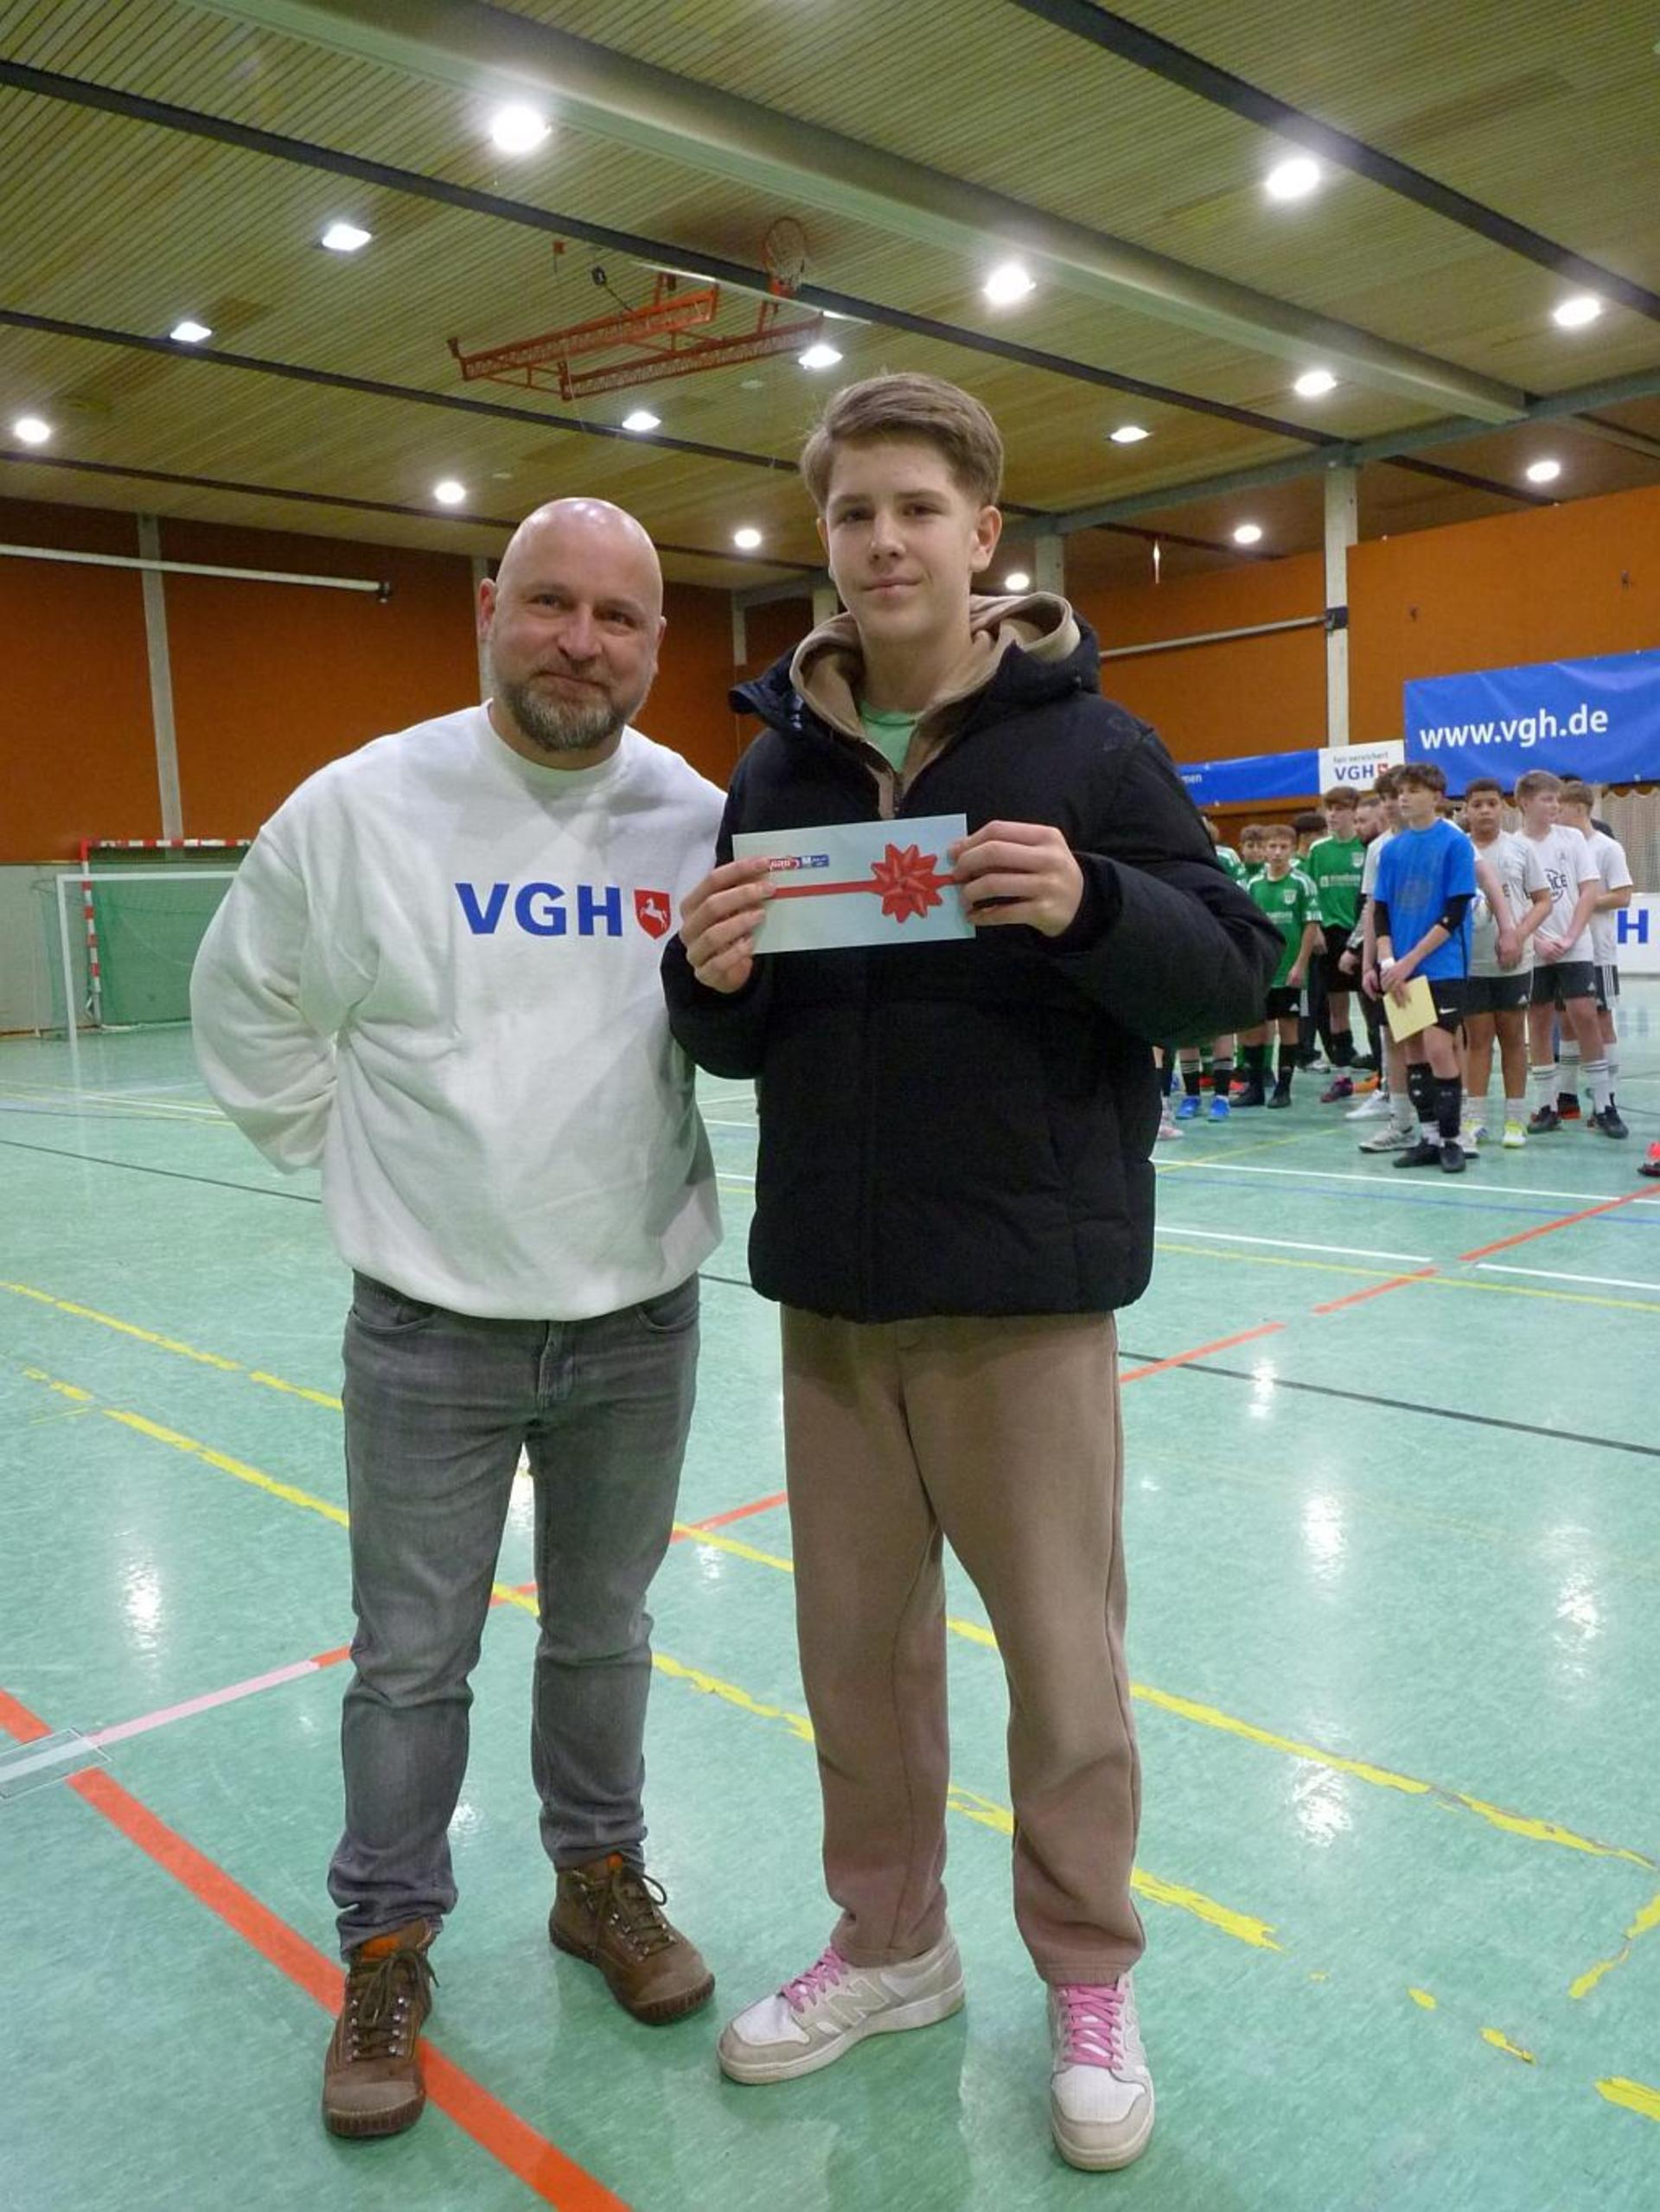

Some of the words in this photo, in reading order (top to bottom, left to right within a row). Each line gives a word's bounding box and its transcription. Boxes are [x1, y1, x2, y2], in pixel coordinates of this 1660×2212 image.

[1420, 704, 1609, 749] www.vgh.de
[1335, 764, 1374, 781] VGH
[455, 883, 623, 937] VGH
